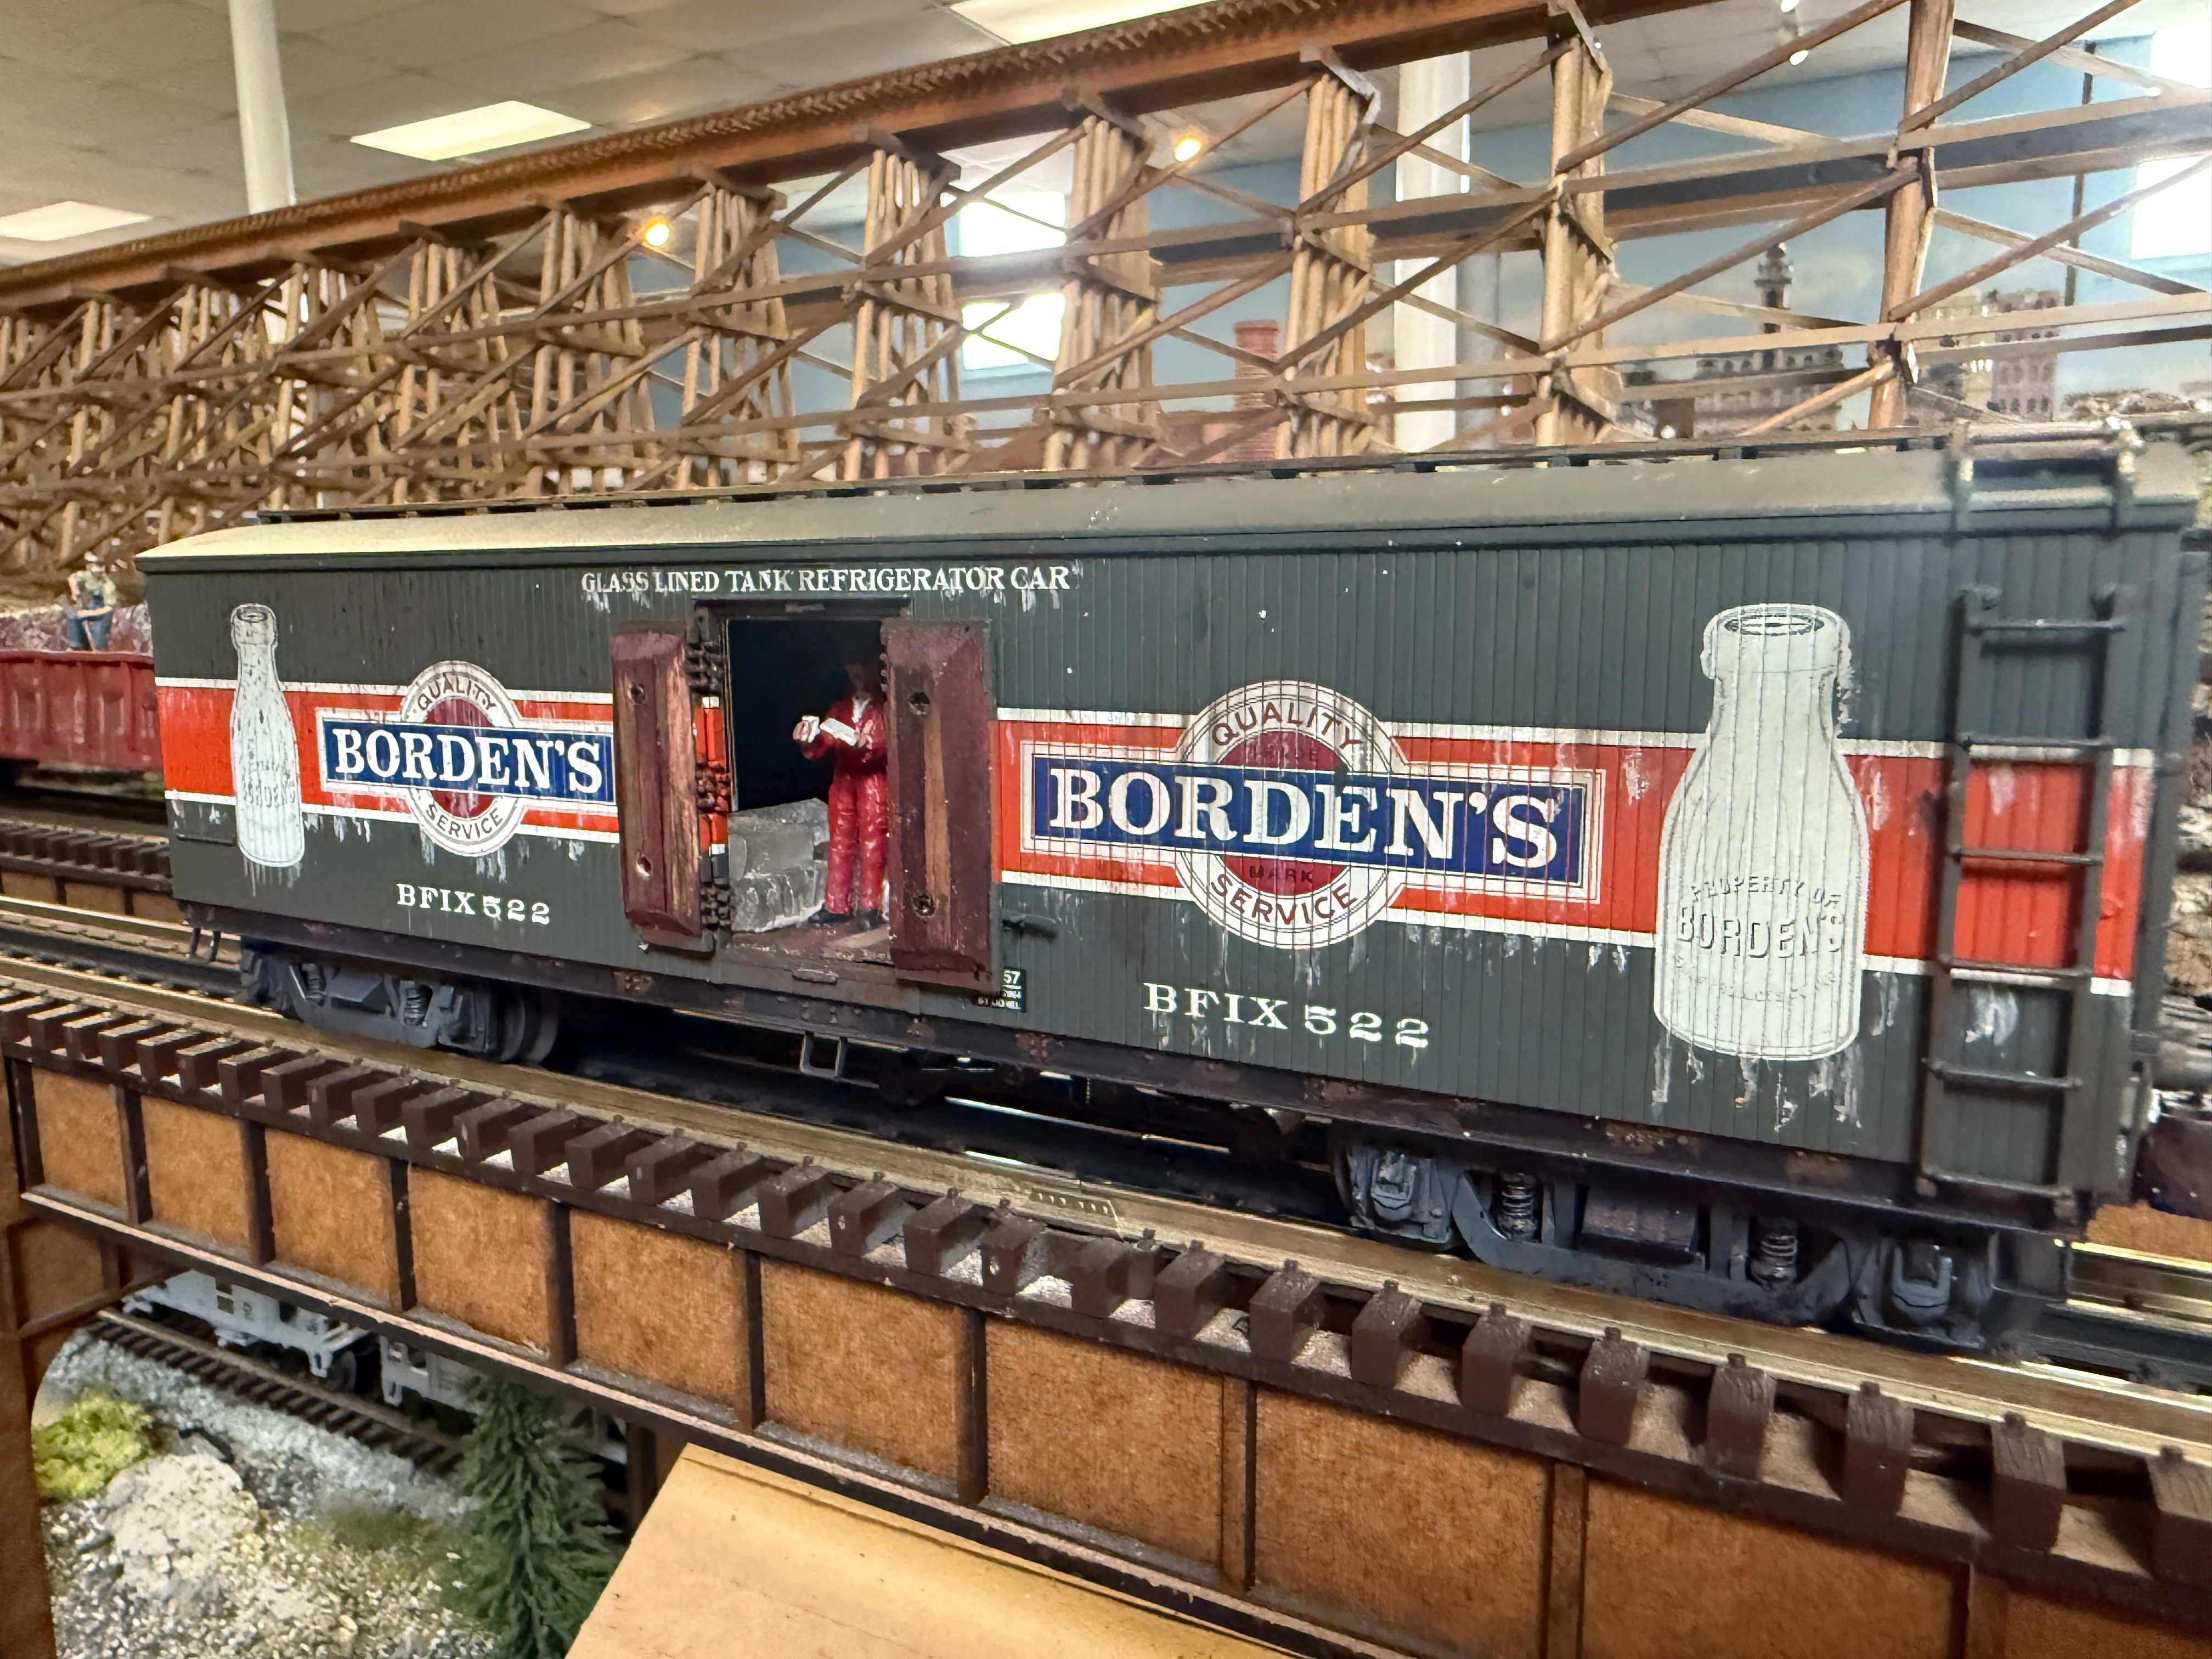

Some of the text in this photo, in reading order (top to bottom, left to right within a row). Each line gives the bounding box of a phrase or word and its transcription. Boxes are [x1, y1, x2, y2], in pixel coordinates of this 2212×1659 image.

[582, 566, 1071, 593] GLASS LINED TANK REFRIGERATOR CAR
[417, 672, 496, 712] QUALITY
[1212, 701, 1363, 749] QUALITY
[332, 727, 602, 794] BORDEN'S
[426, 804, 504, 839] SERVICE
[1048, 767, 1558, 869] BORDEN'S
[1249, 865, 1314, 883] MARK
[396, 883, 550, 926] BFIX 522
[1211, 873, 1358, 925] SERVICE
[1003, 969, 1021, 985] 57
[1142, 982, 1430, 1049] BFIX 522
